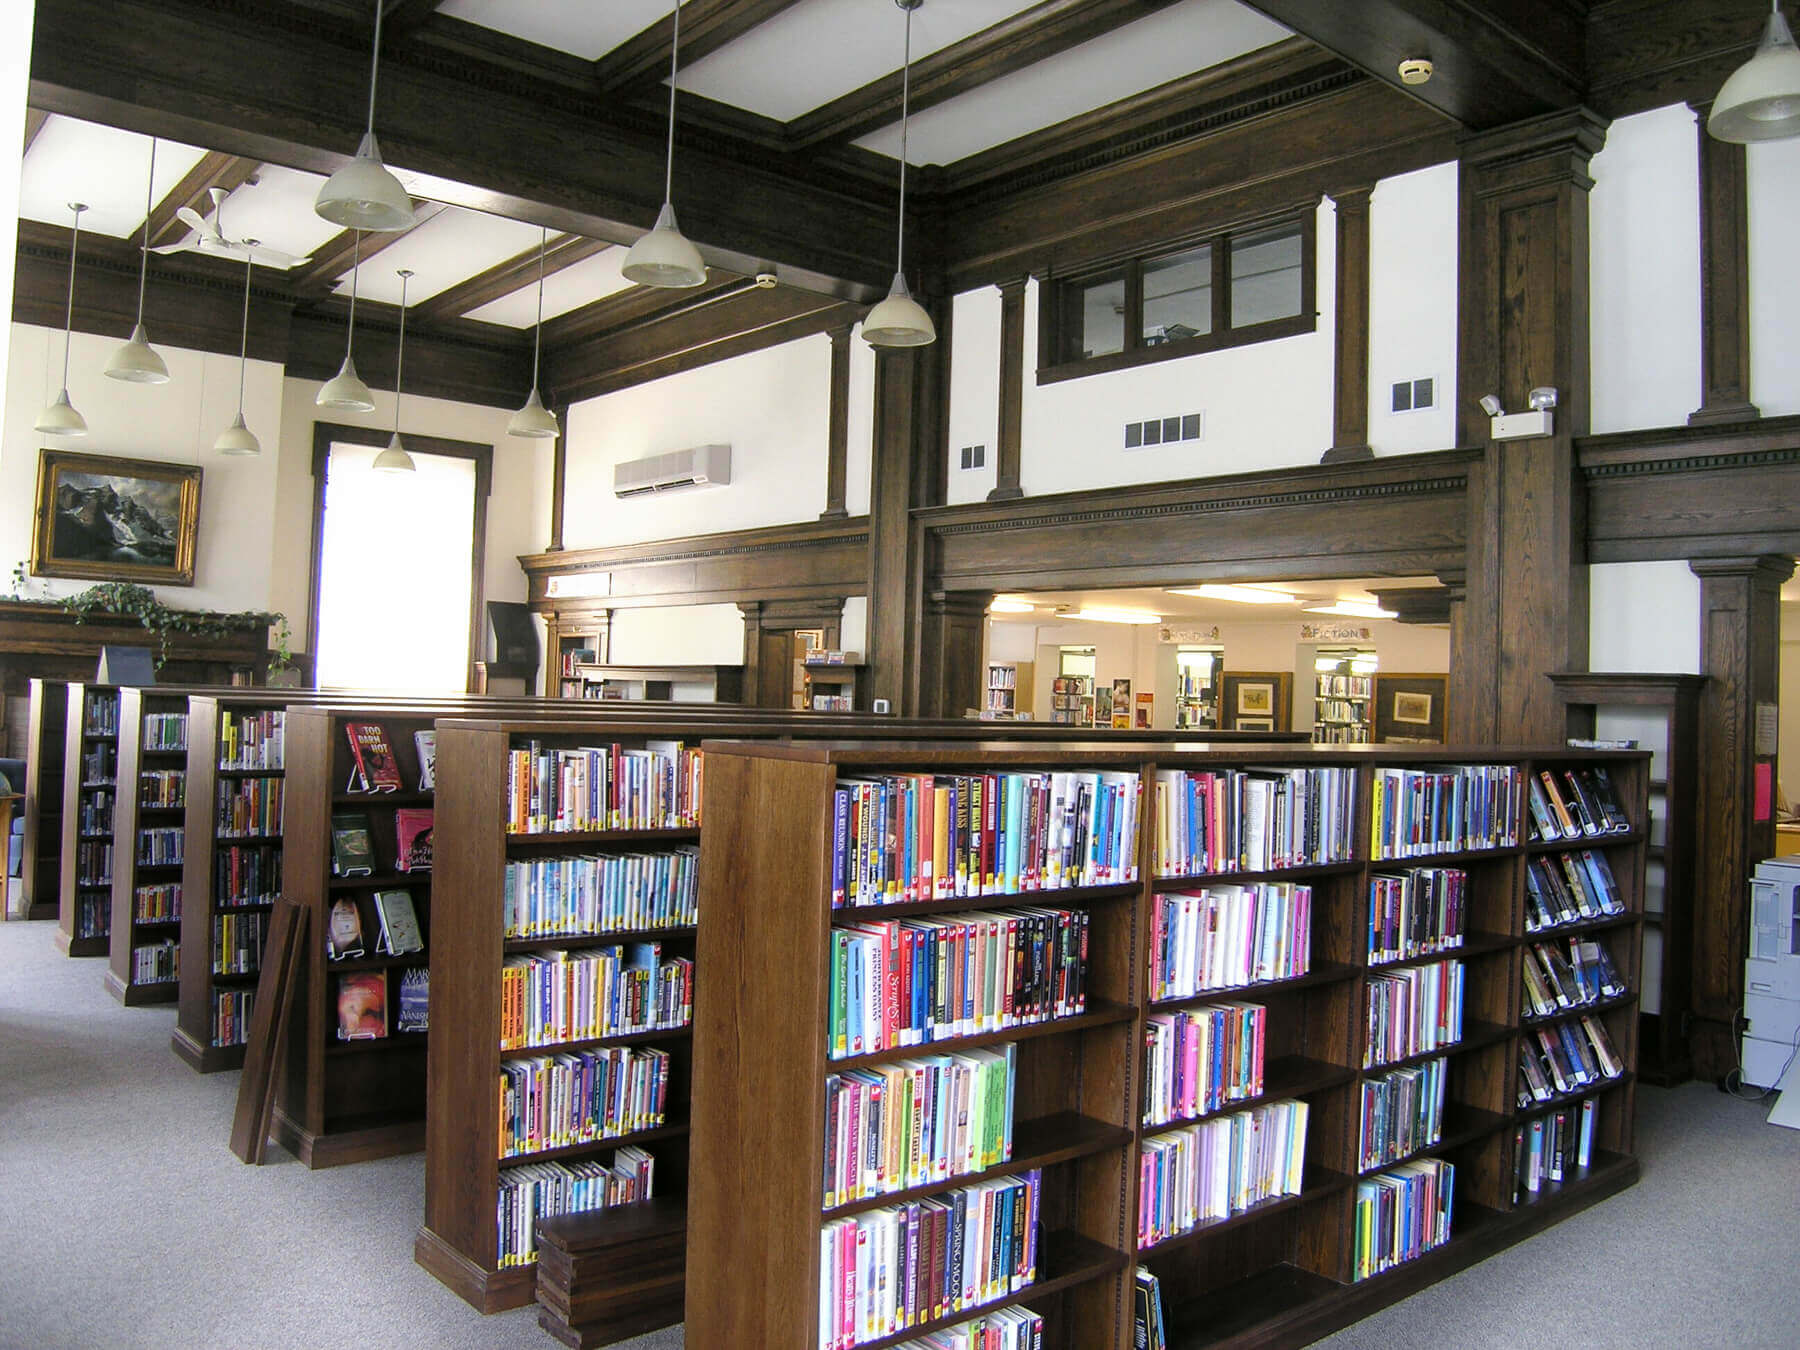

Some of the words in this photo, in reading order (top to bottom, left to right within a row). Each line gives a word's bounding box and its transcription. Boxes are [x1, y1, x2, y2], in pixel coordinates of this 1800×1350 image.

[358, 735, 381, 744] DARN
[364, 726, 381, 735] TOO
[371, 744, 388, 753] HOT
[958, 780, 968, 807] STONE
[839, 794, 847, 816] CLASS
[957, 809, 968, 828] KISS
[838, 818, 846, 851] REUNION
[954, 1223, 962, 1262] SPRING
[952, 1264, 960, 1301] MOON
